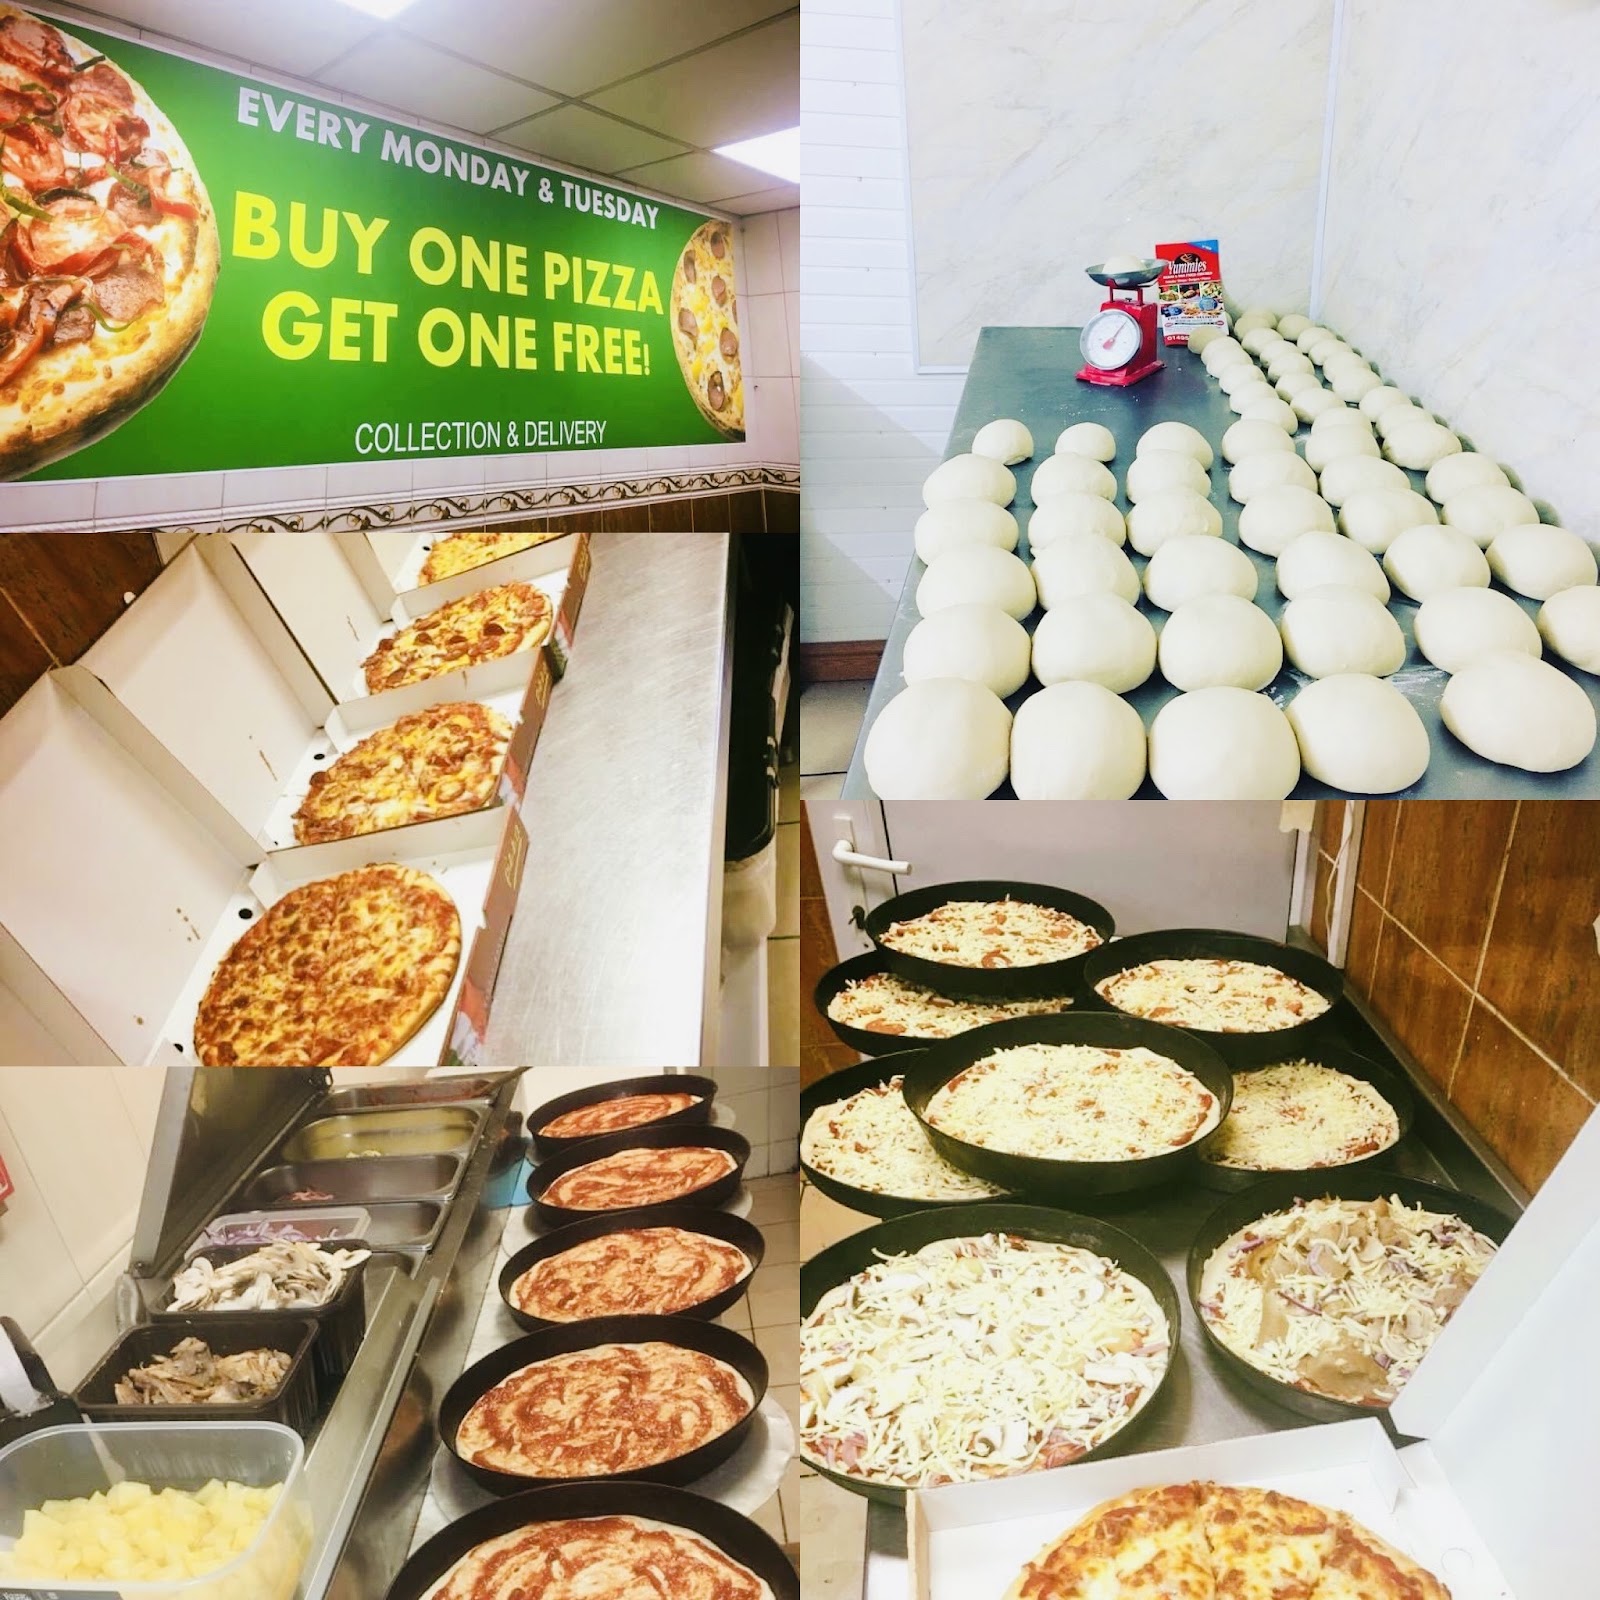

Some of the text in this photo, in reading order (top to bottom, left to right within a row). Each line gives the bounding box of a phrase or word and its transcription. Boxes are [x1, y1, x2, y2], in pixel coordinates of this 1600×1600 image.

[237, 86, 659, 230] EVERY MONDAY & TUESDAY
[231, 189, 665, 316] BUY ONE PIZZA
[1168, 257, 1207, 274] Yummies
[261, 290, 651, 376] GET ONE FREE!
[355, 420, 607, 455] COLLECTION & DELIVERY
